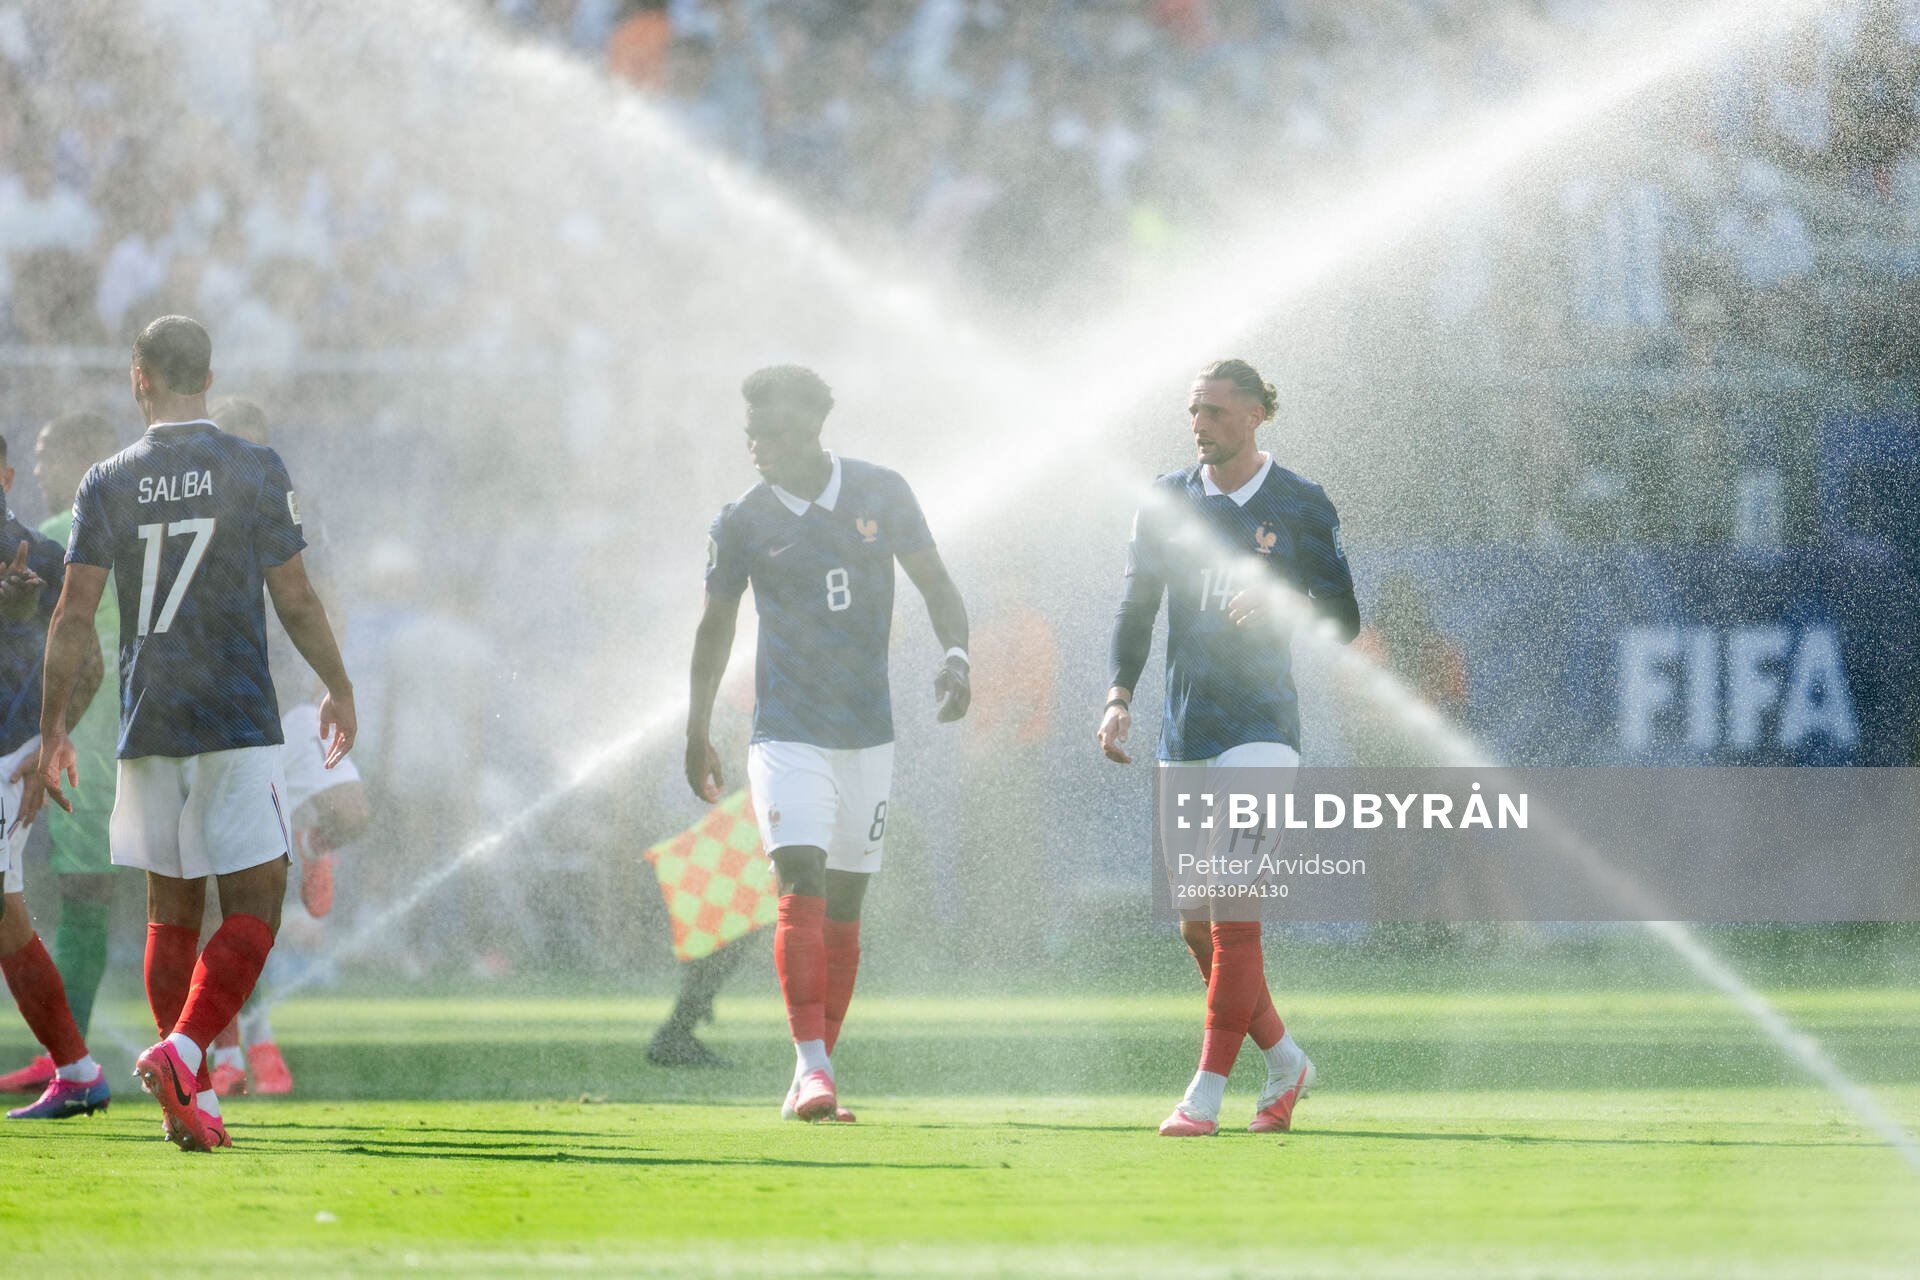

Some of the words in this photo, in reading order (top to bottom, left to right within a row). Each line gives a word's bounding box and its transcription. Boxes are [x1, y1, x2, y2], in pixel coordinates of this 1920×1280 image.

[138, 470, 213, 504] SALBA
[137, 517, 216, 636] 17
[825, 567, 851, 611] 8
[1200, 568, 1236, 611] 14
[1620, 624, 1860, 749] FIFA
[869, 800, 887, 842] 8
